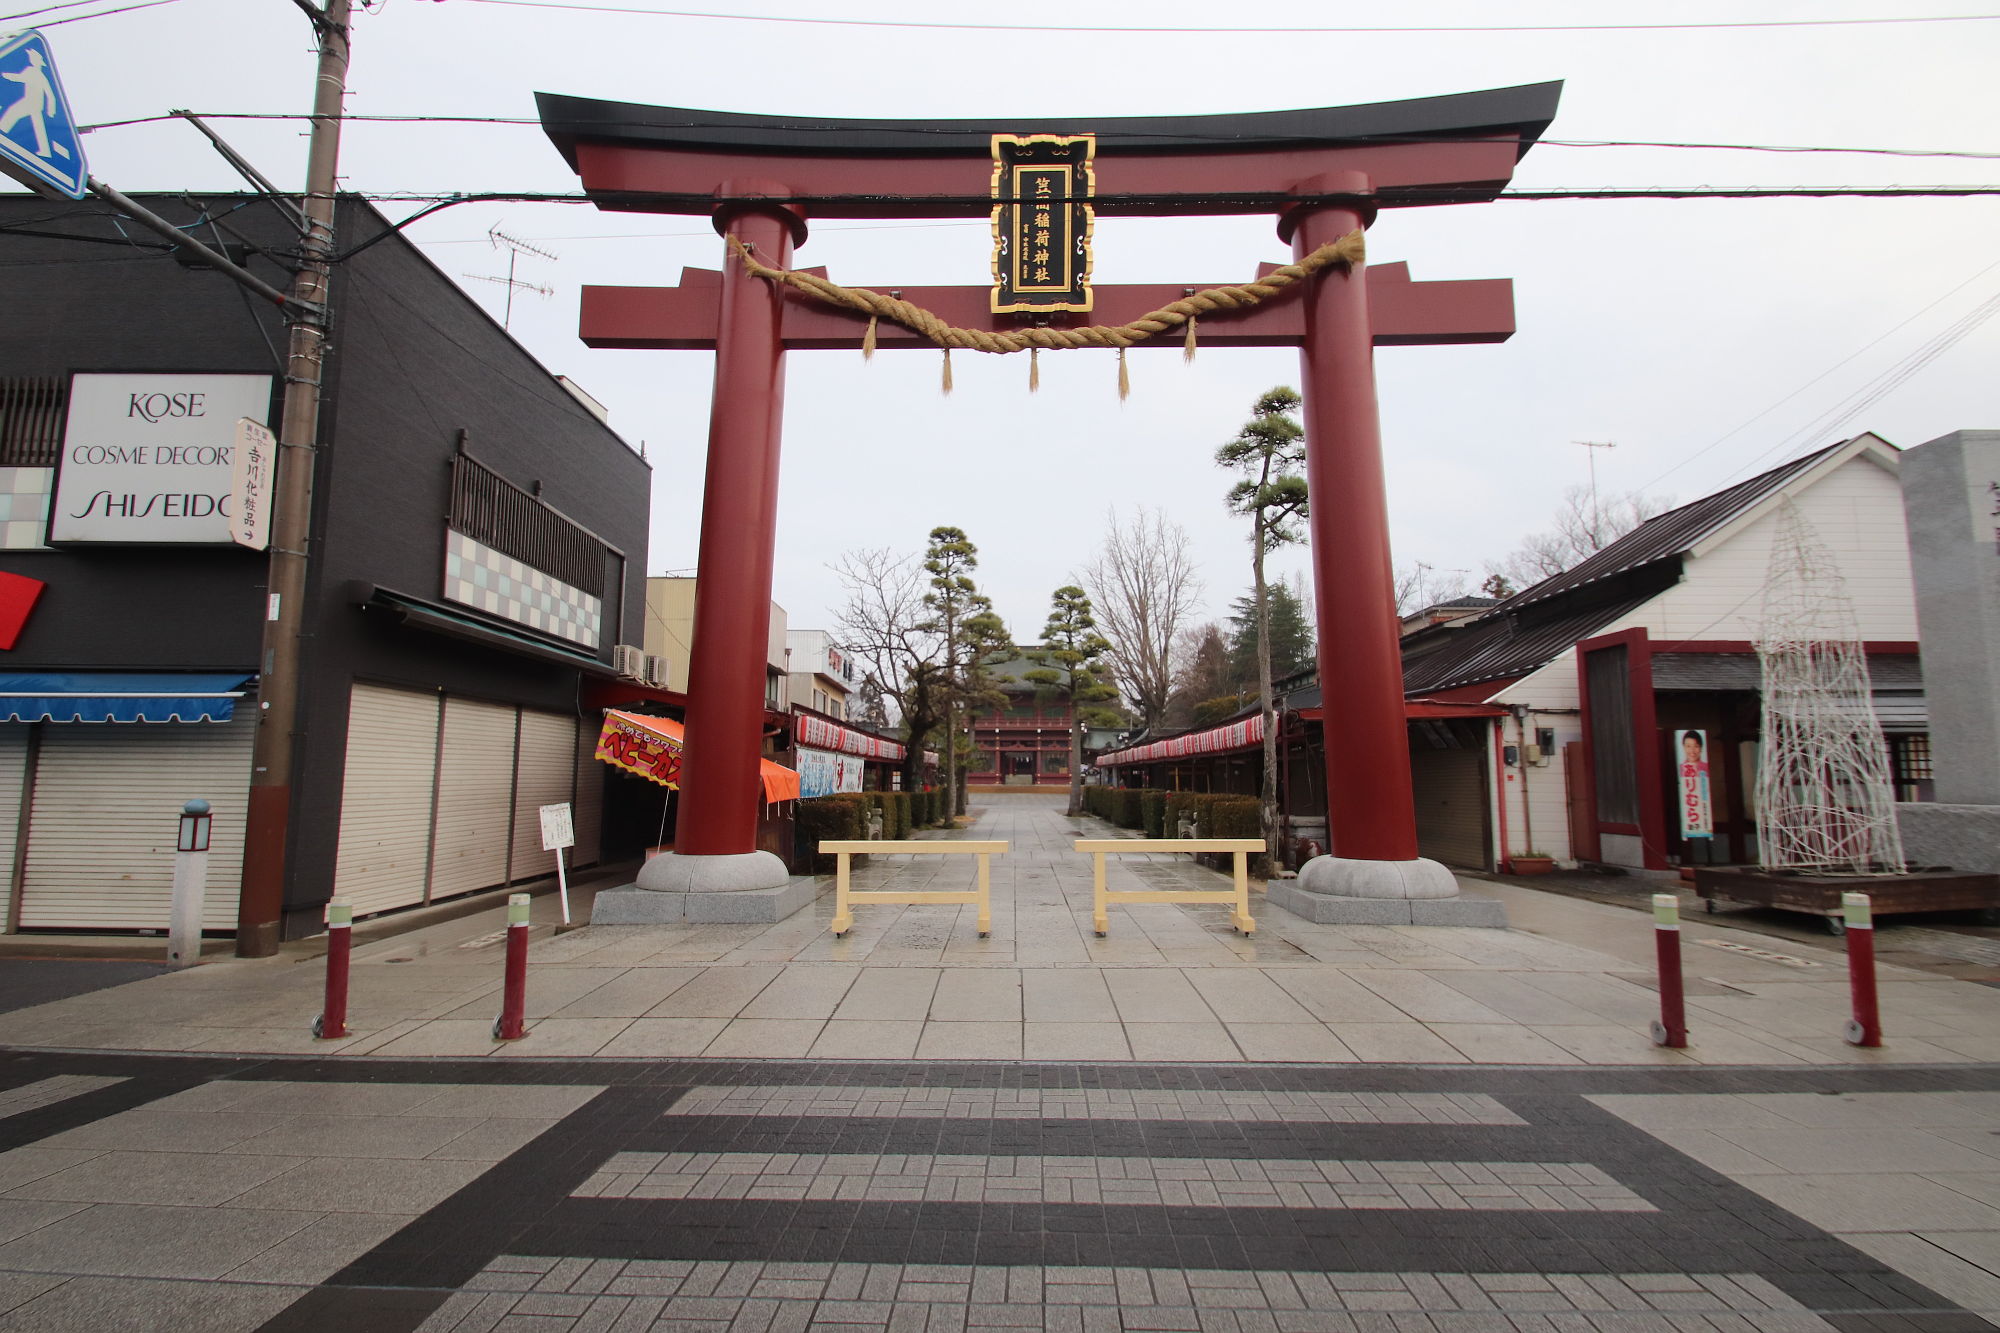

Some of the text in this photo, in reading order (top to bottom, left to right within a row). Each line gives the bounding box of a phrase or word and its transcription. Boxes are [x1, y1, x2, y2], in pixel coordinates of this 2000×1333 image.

[128, 393, 206, 423] KOSE
[73, 445, 149, 465] COSME
[244, 447, 261, 526] 吉川化粧品
[616, 722, 683, 753] 冷めてもフワフ
[1684, 764, 1700, 823] ありむら
